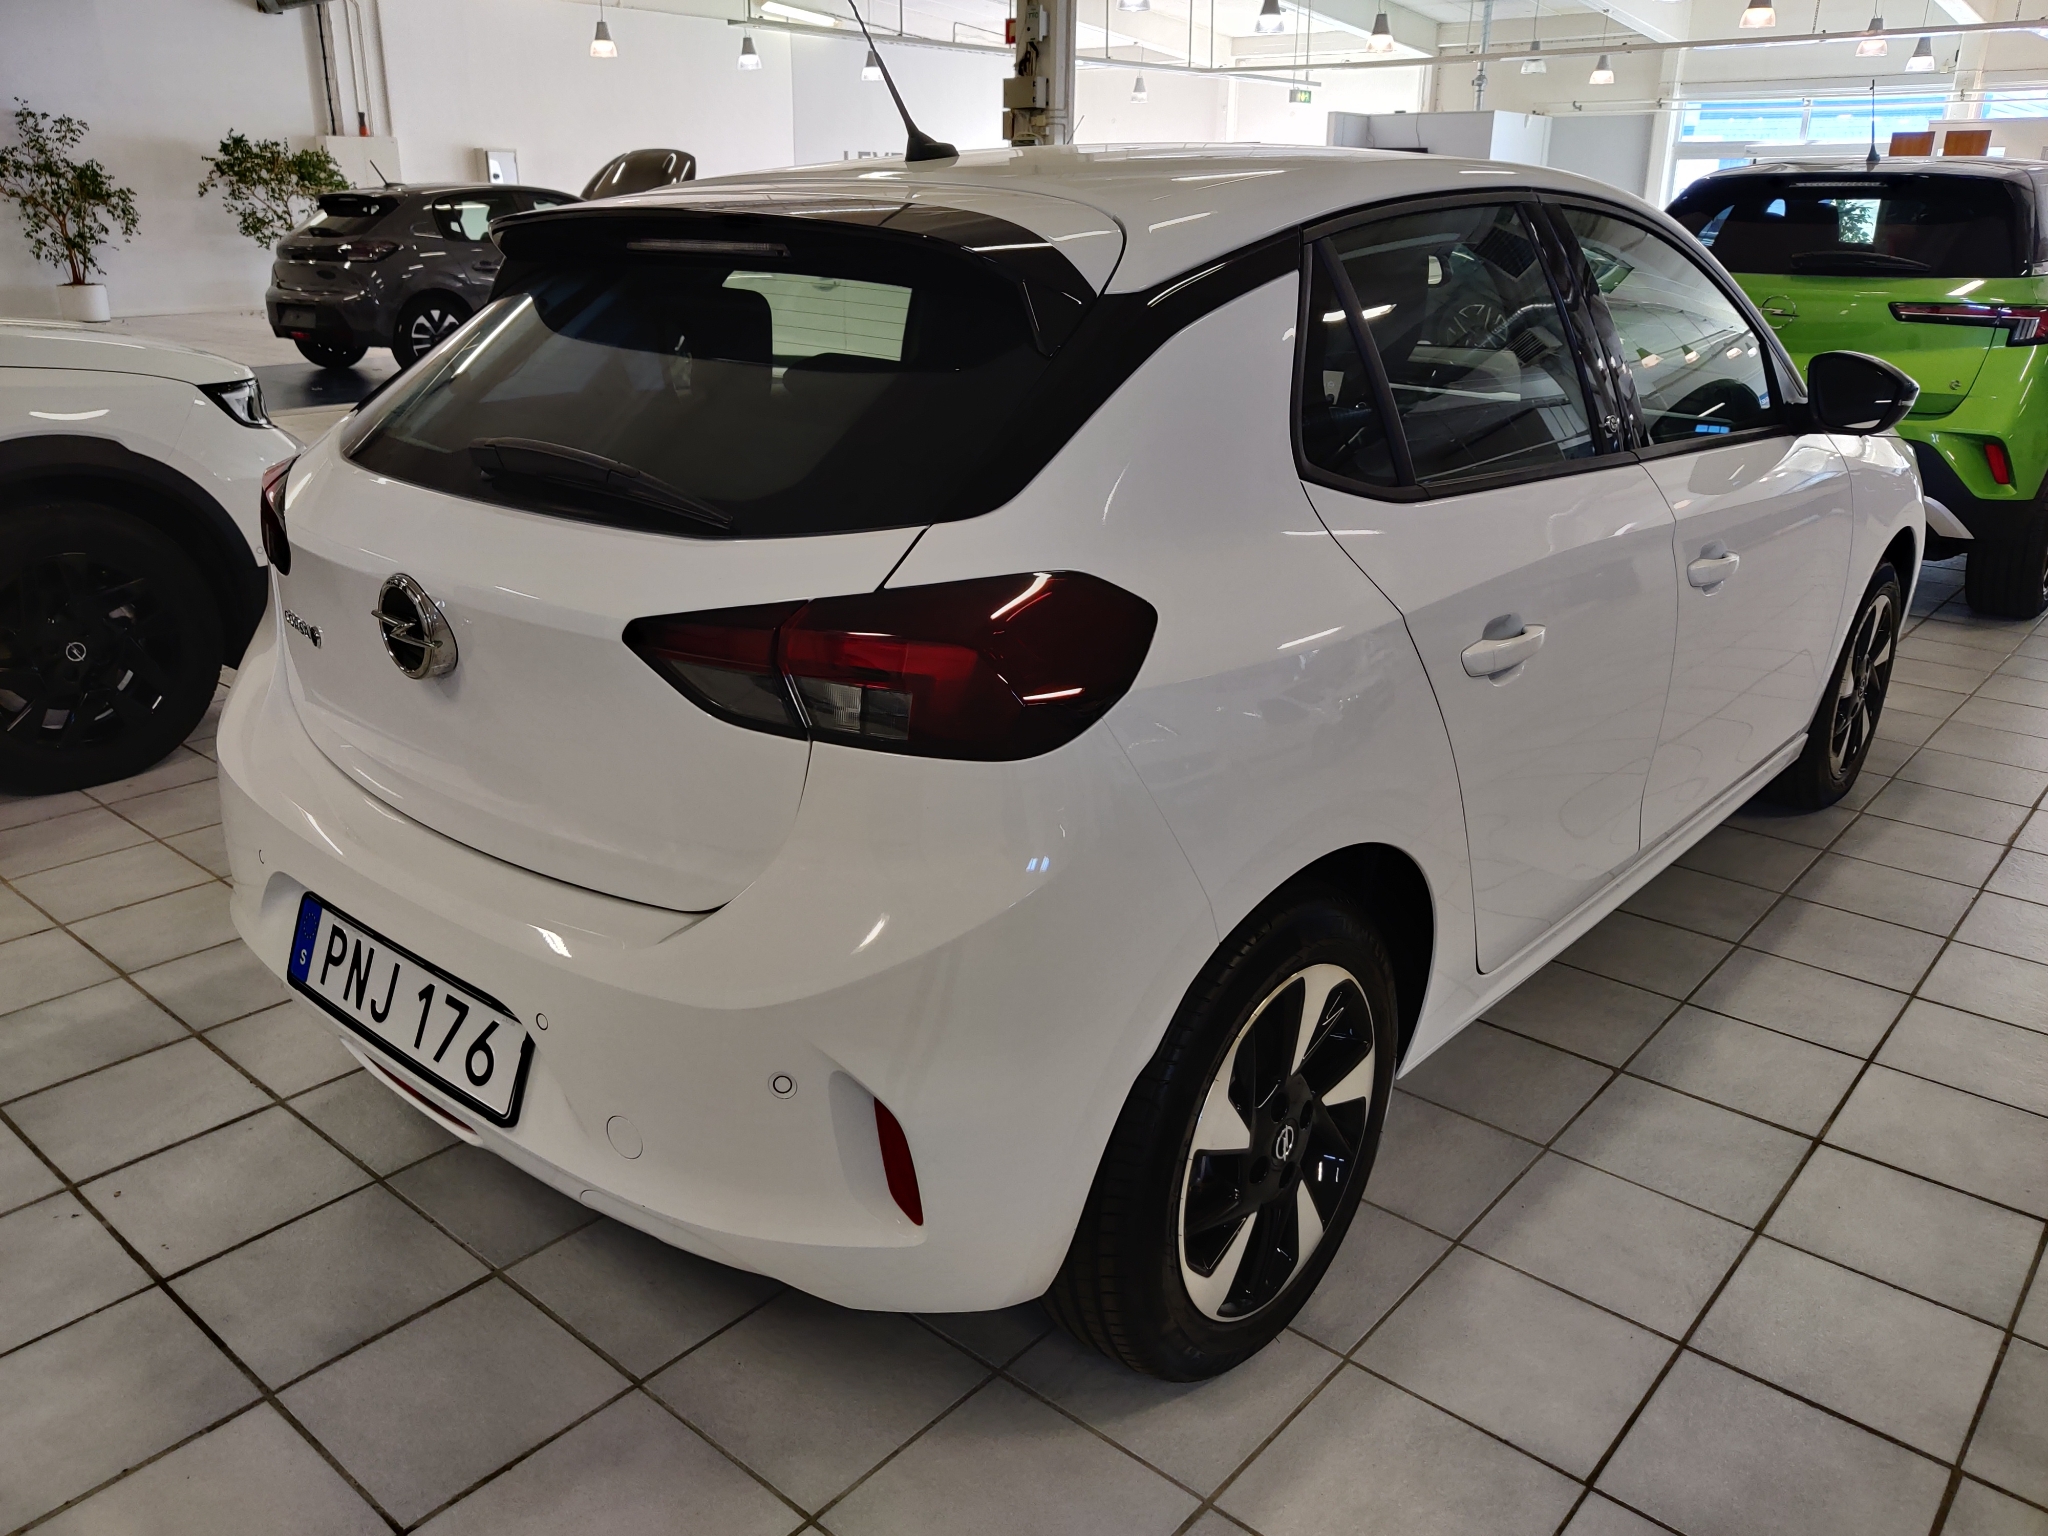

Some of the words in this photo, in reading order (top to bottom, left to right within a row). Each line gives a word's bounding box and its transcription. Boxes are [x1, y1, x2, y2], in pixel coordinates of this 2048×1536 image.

[299, 948, 308, 965] S
[319, 923, 401, 1024] PNJ
[413, 983, 501, 1087] 176
